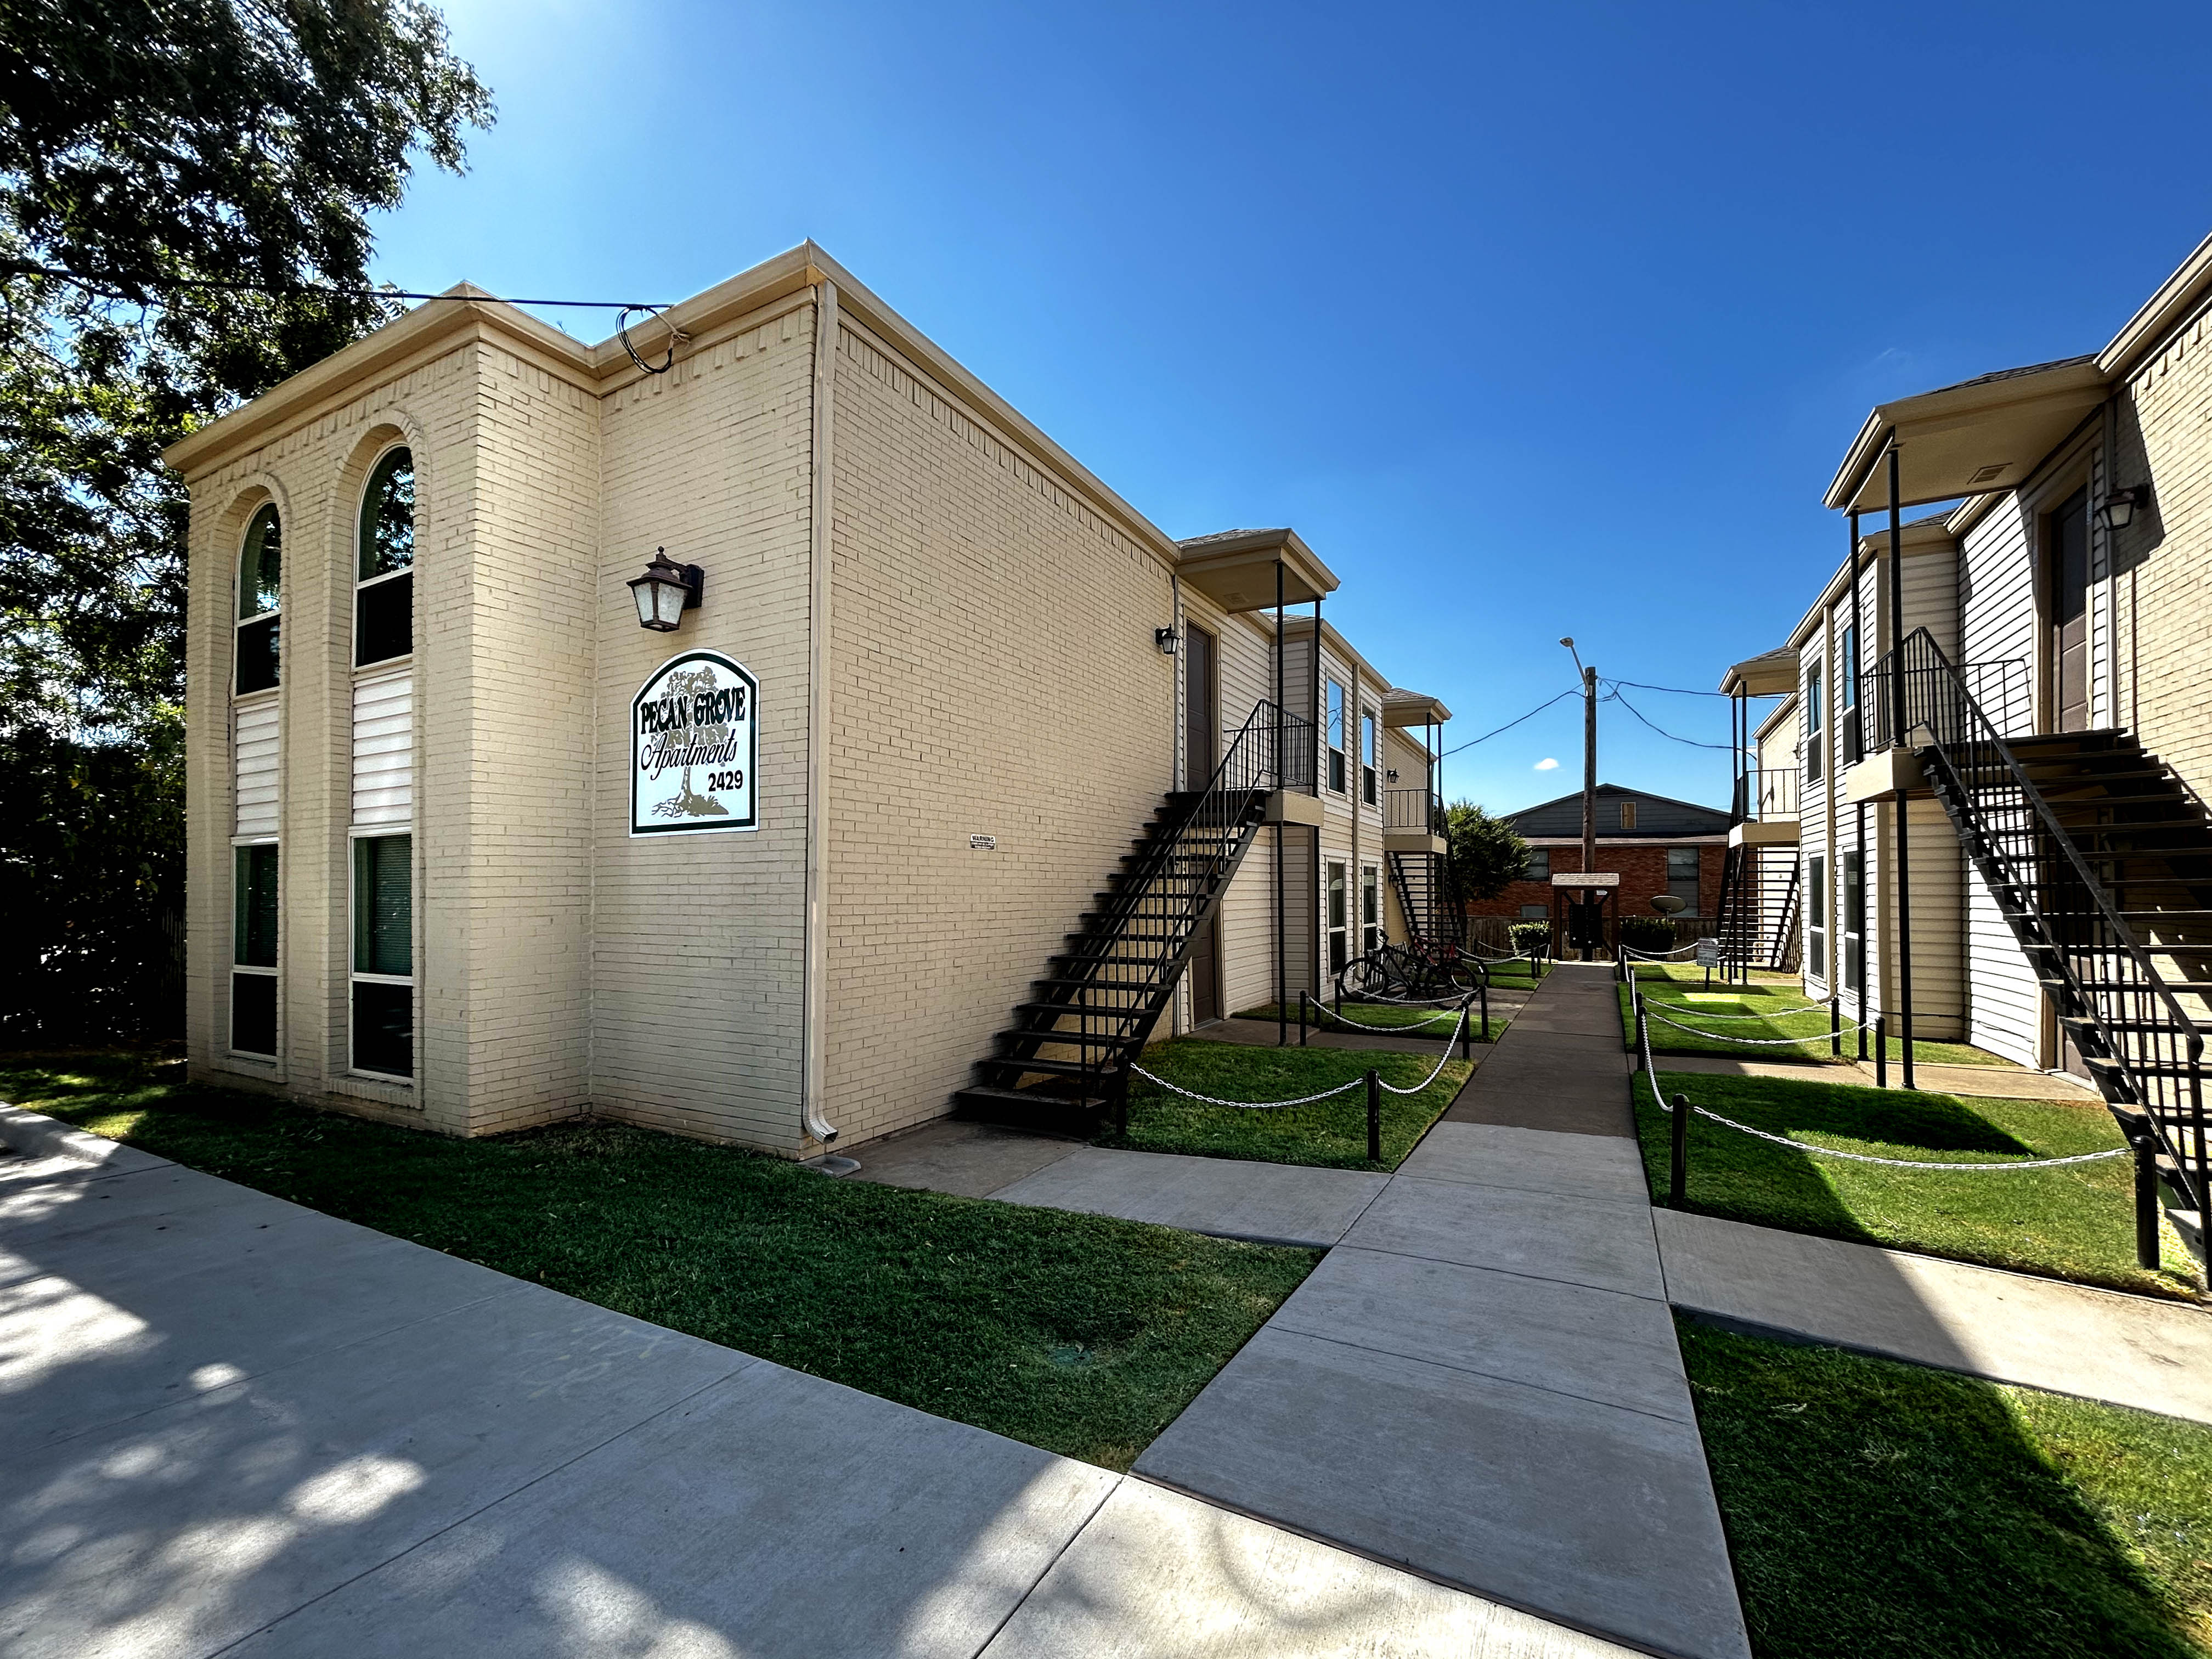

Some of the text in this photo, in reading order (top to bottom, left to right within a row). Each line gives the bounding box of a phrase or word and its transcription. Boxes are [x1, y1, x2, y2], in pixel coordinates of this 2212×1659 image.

[640, 686, 746, 734] PECAN GROVE
[641, 729, 737, 780] Apartments
[708, 770, 743, 792] 2429
